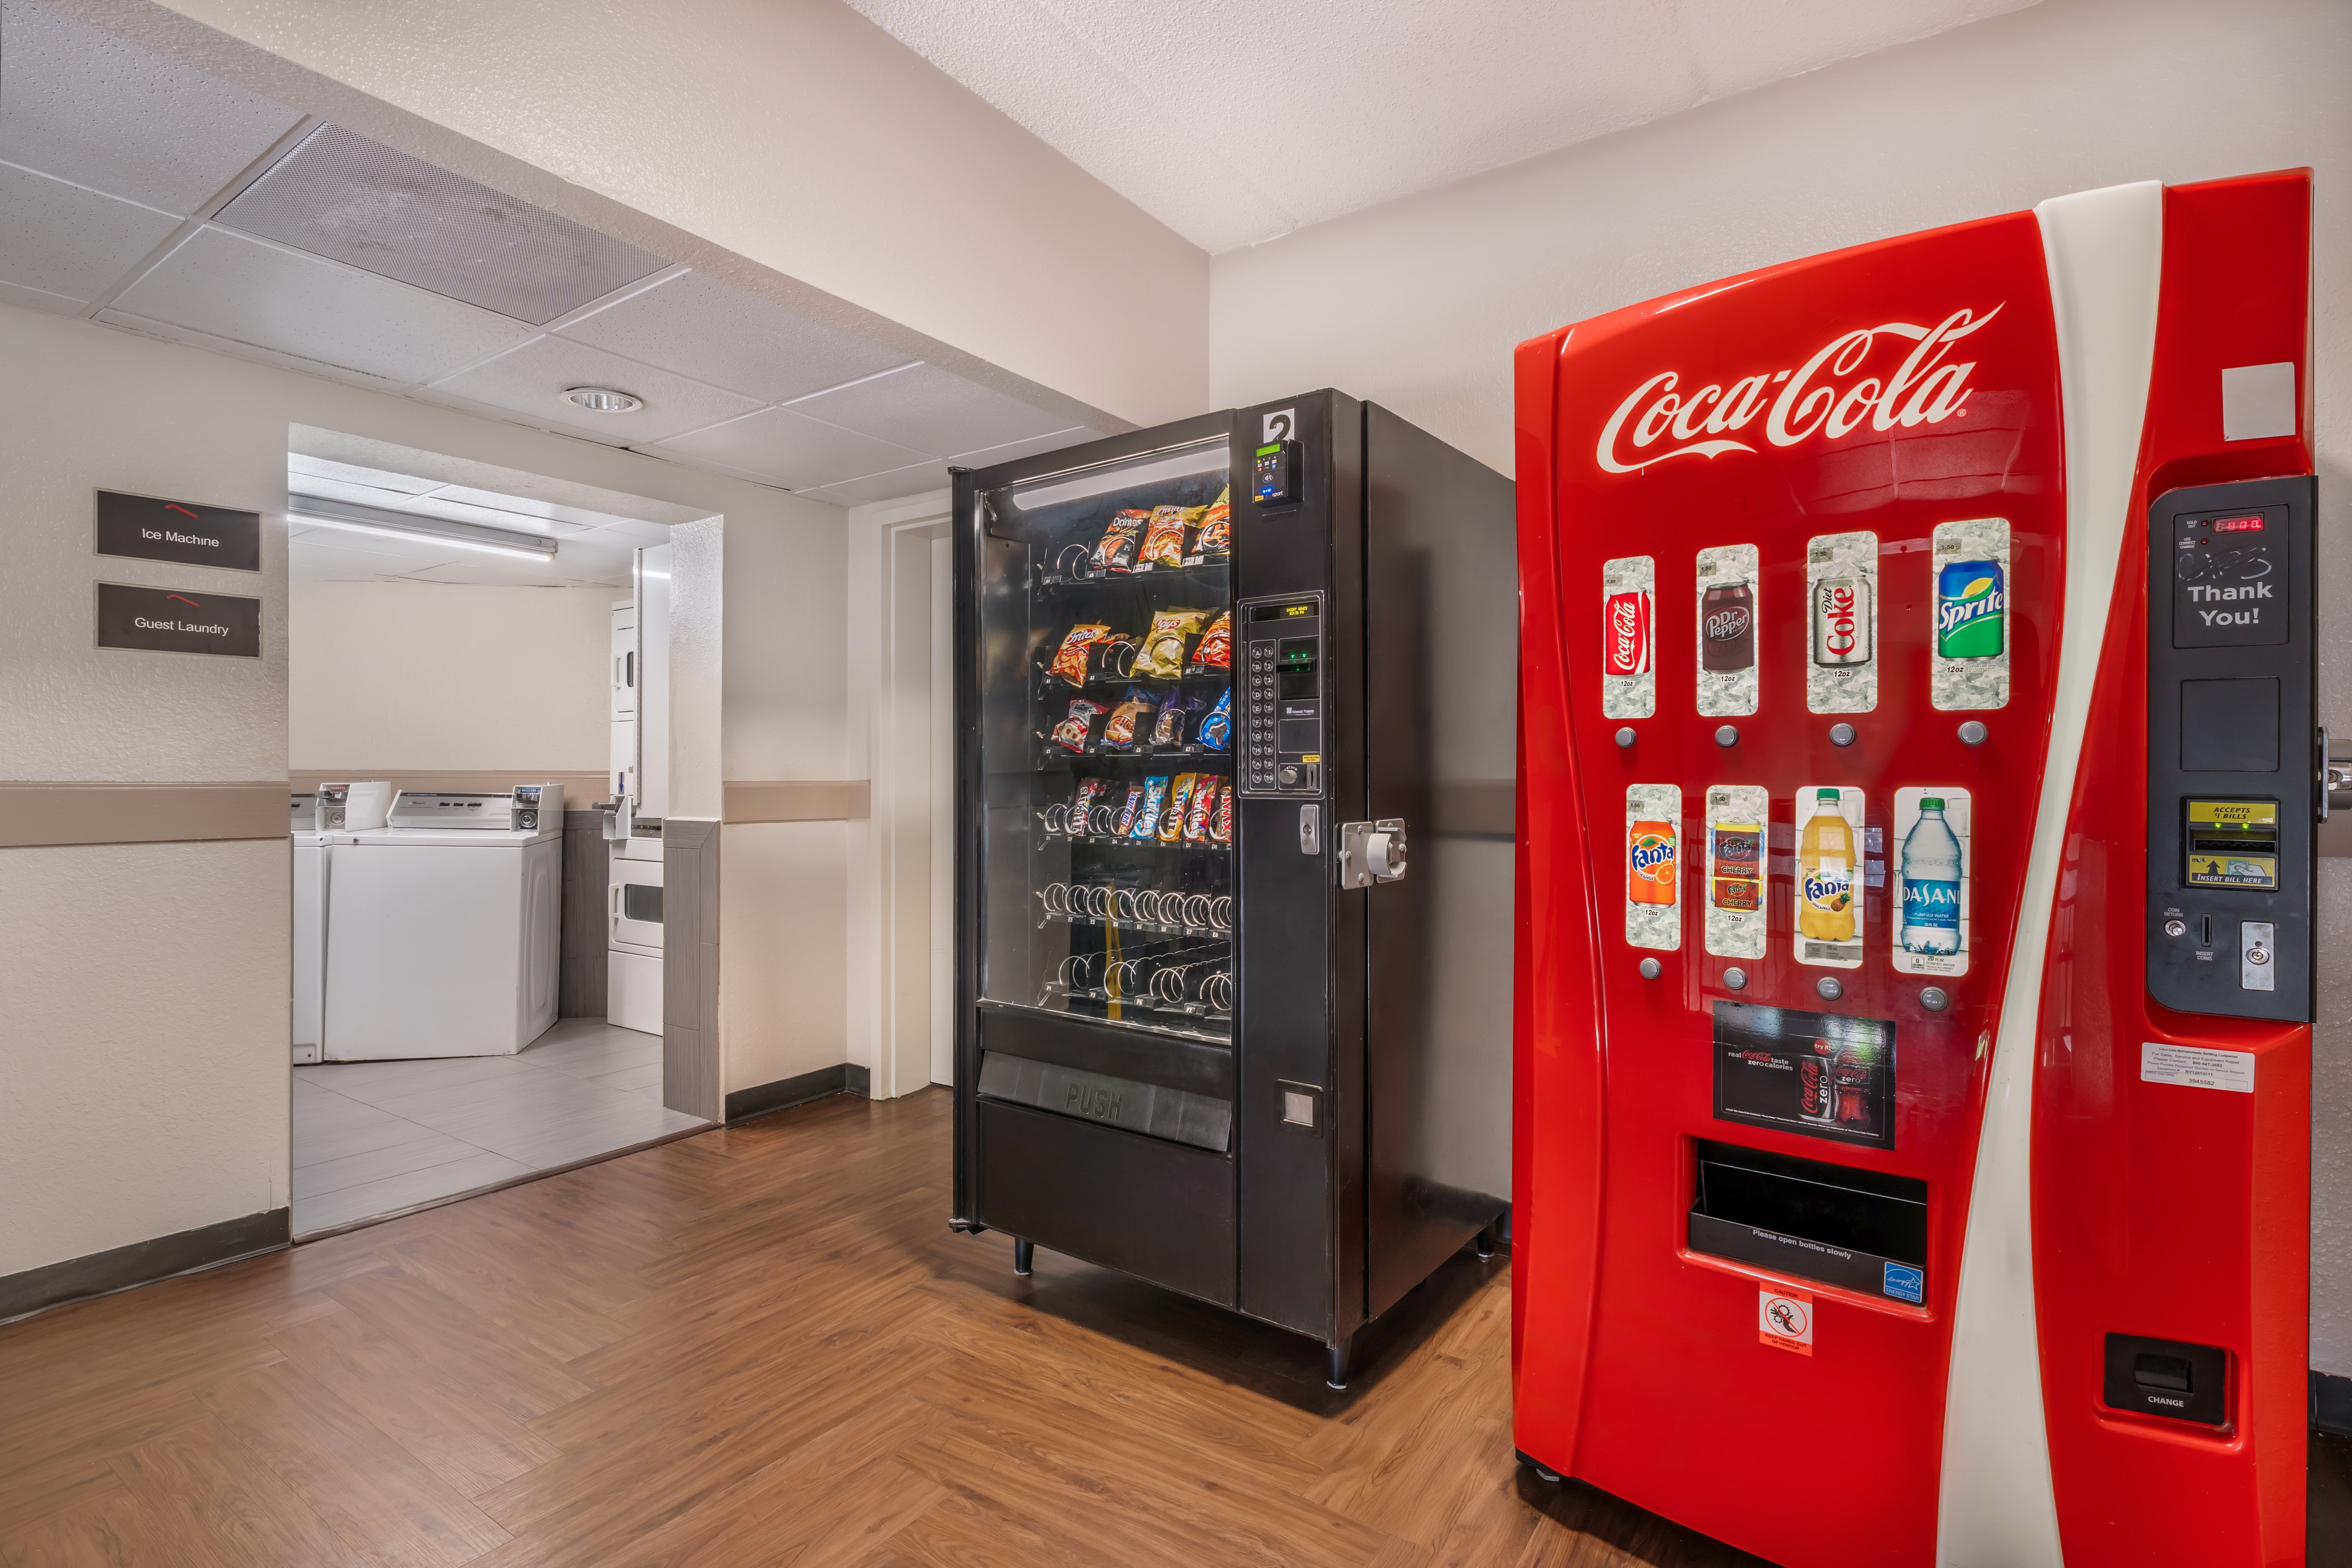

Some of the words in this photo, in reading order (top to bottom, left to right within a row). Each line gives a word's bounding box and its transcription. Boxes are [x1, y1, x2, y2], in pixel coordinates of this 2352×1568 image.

[1597, 301, 2006, 473] Coca-Cola
[1269, 414, 1291, 443] 2
[1113, 517, 1143, 526] Doritos
[142, 528, 162, 539] Ice
[166, 531, 219, 547] Machine
[1822, 588, 1832, 613] Diet
[2187, 582, 2273, 602] Thank
[1720, 611, 1738, 626] Dr
[1827, 586, 1855, 655] Coke
[1939, 588, 2003, 633] Sprite
[2199, 608, 2259, 626] You!
[135, 617, 174, 630] Guest
[178, 621, 229, 637] Laundry
[1613, 600, 1635, 670] Coca-Cola
[1706, 614, 1747, 638] Pepper
[1122, 793, 1137, 826] SNICKERS
[1142, 786, 1162, 836] Skittles
[1191, 789, 1207, 837] Skittles
[1631, 842, 1673, 871] Fanta
[1719, 841, 1751, 858] Fanta
[1638, 872, 1654, 881] ORANGE
[1721, 866, 1752, 875] CHERRY
[1727, 885, 1746, 895] Fanta
[1805, 877, 1849, 902] Fanta
[1904, 883, 1960, 906] DASANI
[1722, 898, 1752, 907] CHERRY
[1812, 902, 1831, 911] PINEAPPLE
[1742, 1050, 1771, 1062] Coca-Cola
[1801, 1060, 1818, 1113] Coca-Cola
[1065, 1083, 1123, 1122] PUSH
[1753, 1229, 1777, 1240] Please
[1779, 1236, 1797, 1245] open
[1799, 1240, 1825, 1252] bottles
[1827, 1248, 1851, 1259] slowly
[1774, 1289, 1798, 1298] CAUTION
[1886, 1288, 1906, 1297] ENERGY
[1779, 1341, 1799, 1350] VENDOR
[2148, 1396, 2184, 1407] CHANGE
